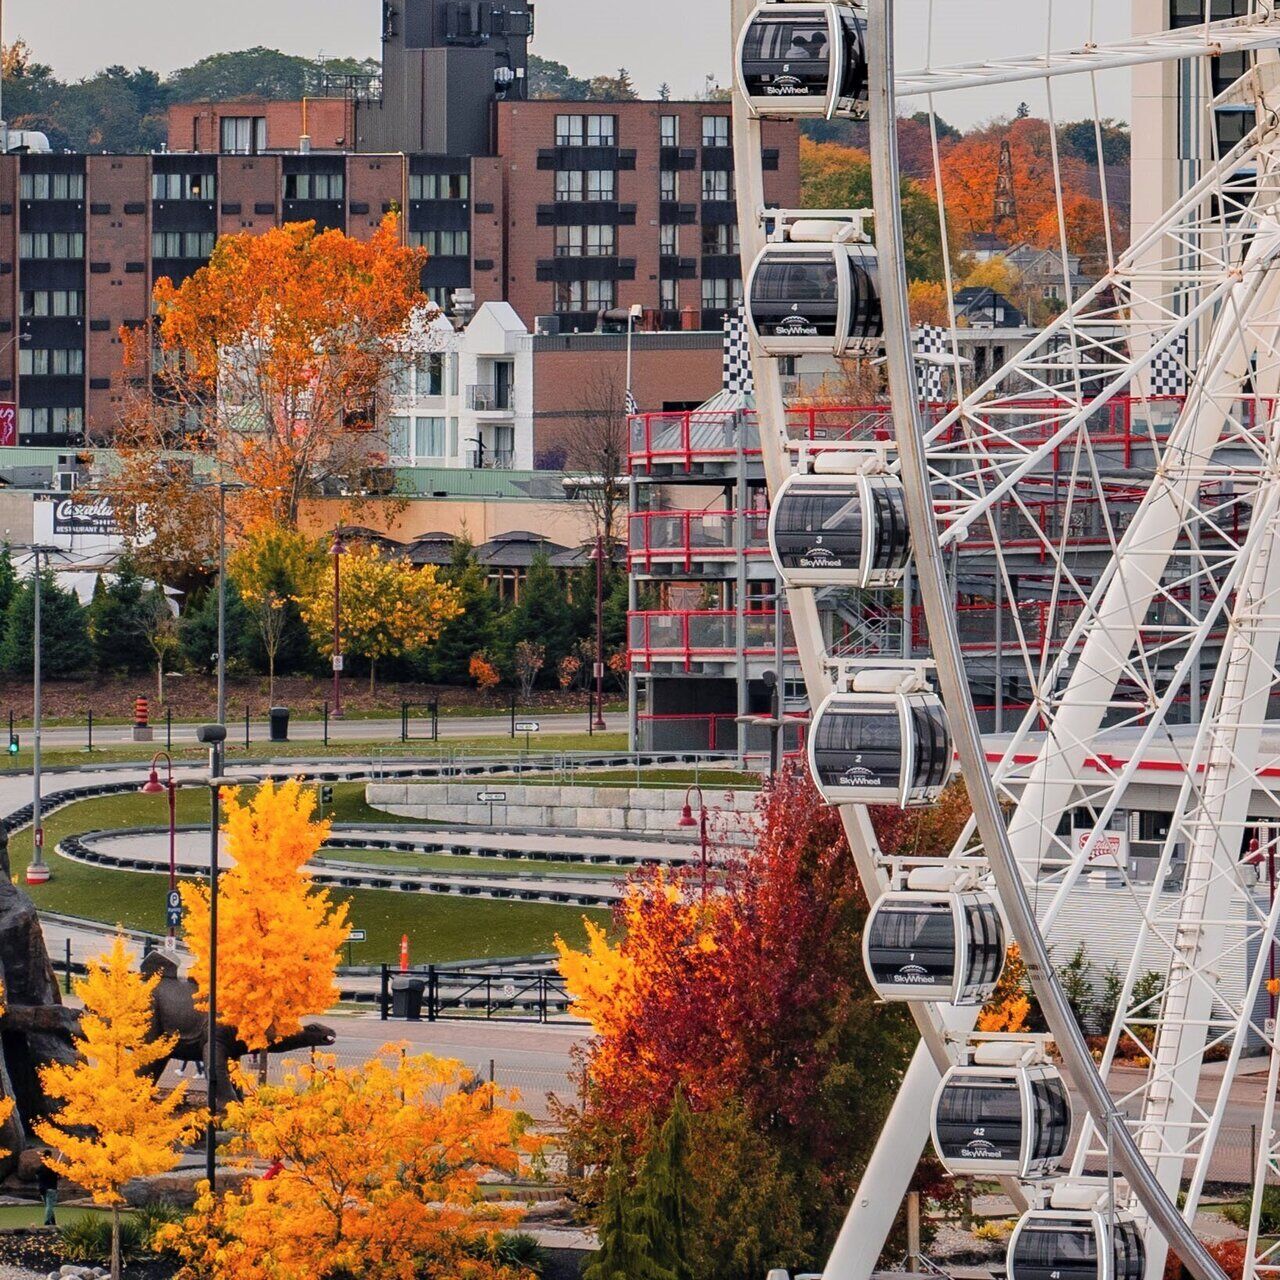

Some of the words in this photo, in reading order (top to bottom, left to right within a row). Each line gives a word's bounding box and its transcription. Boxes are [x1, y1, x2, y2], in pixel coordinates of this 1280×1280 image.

[767, 87, 808, 95] SkyWheel
[800, 559, 842, 567] SkyWheel
[839, 777, 880, 785] SkyWheel
[894, 975, 934, 983] SkyWheel
[962, 1149, 1001, 1158] SkyWheel
